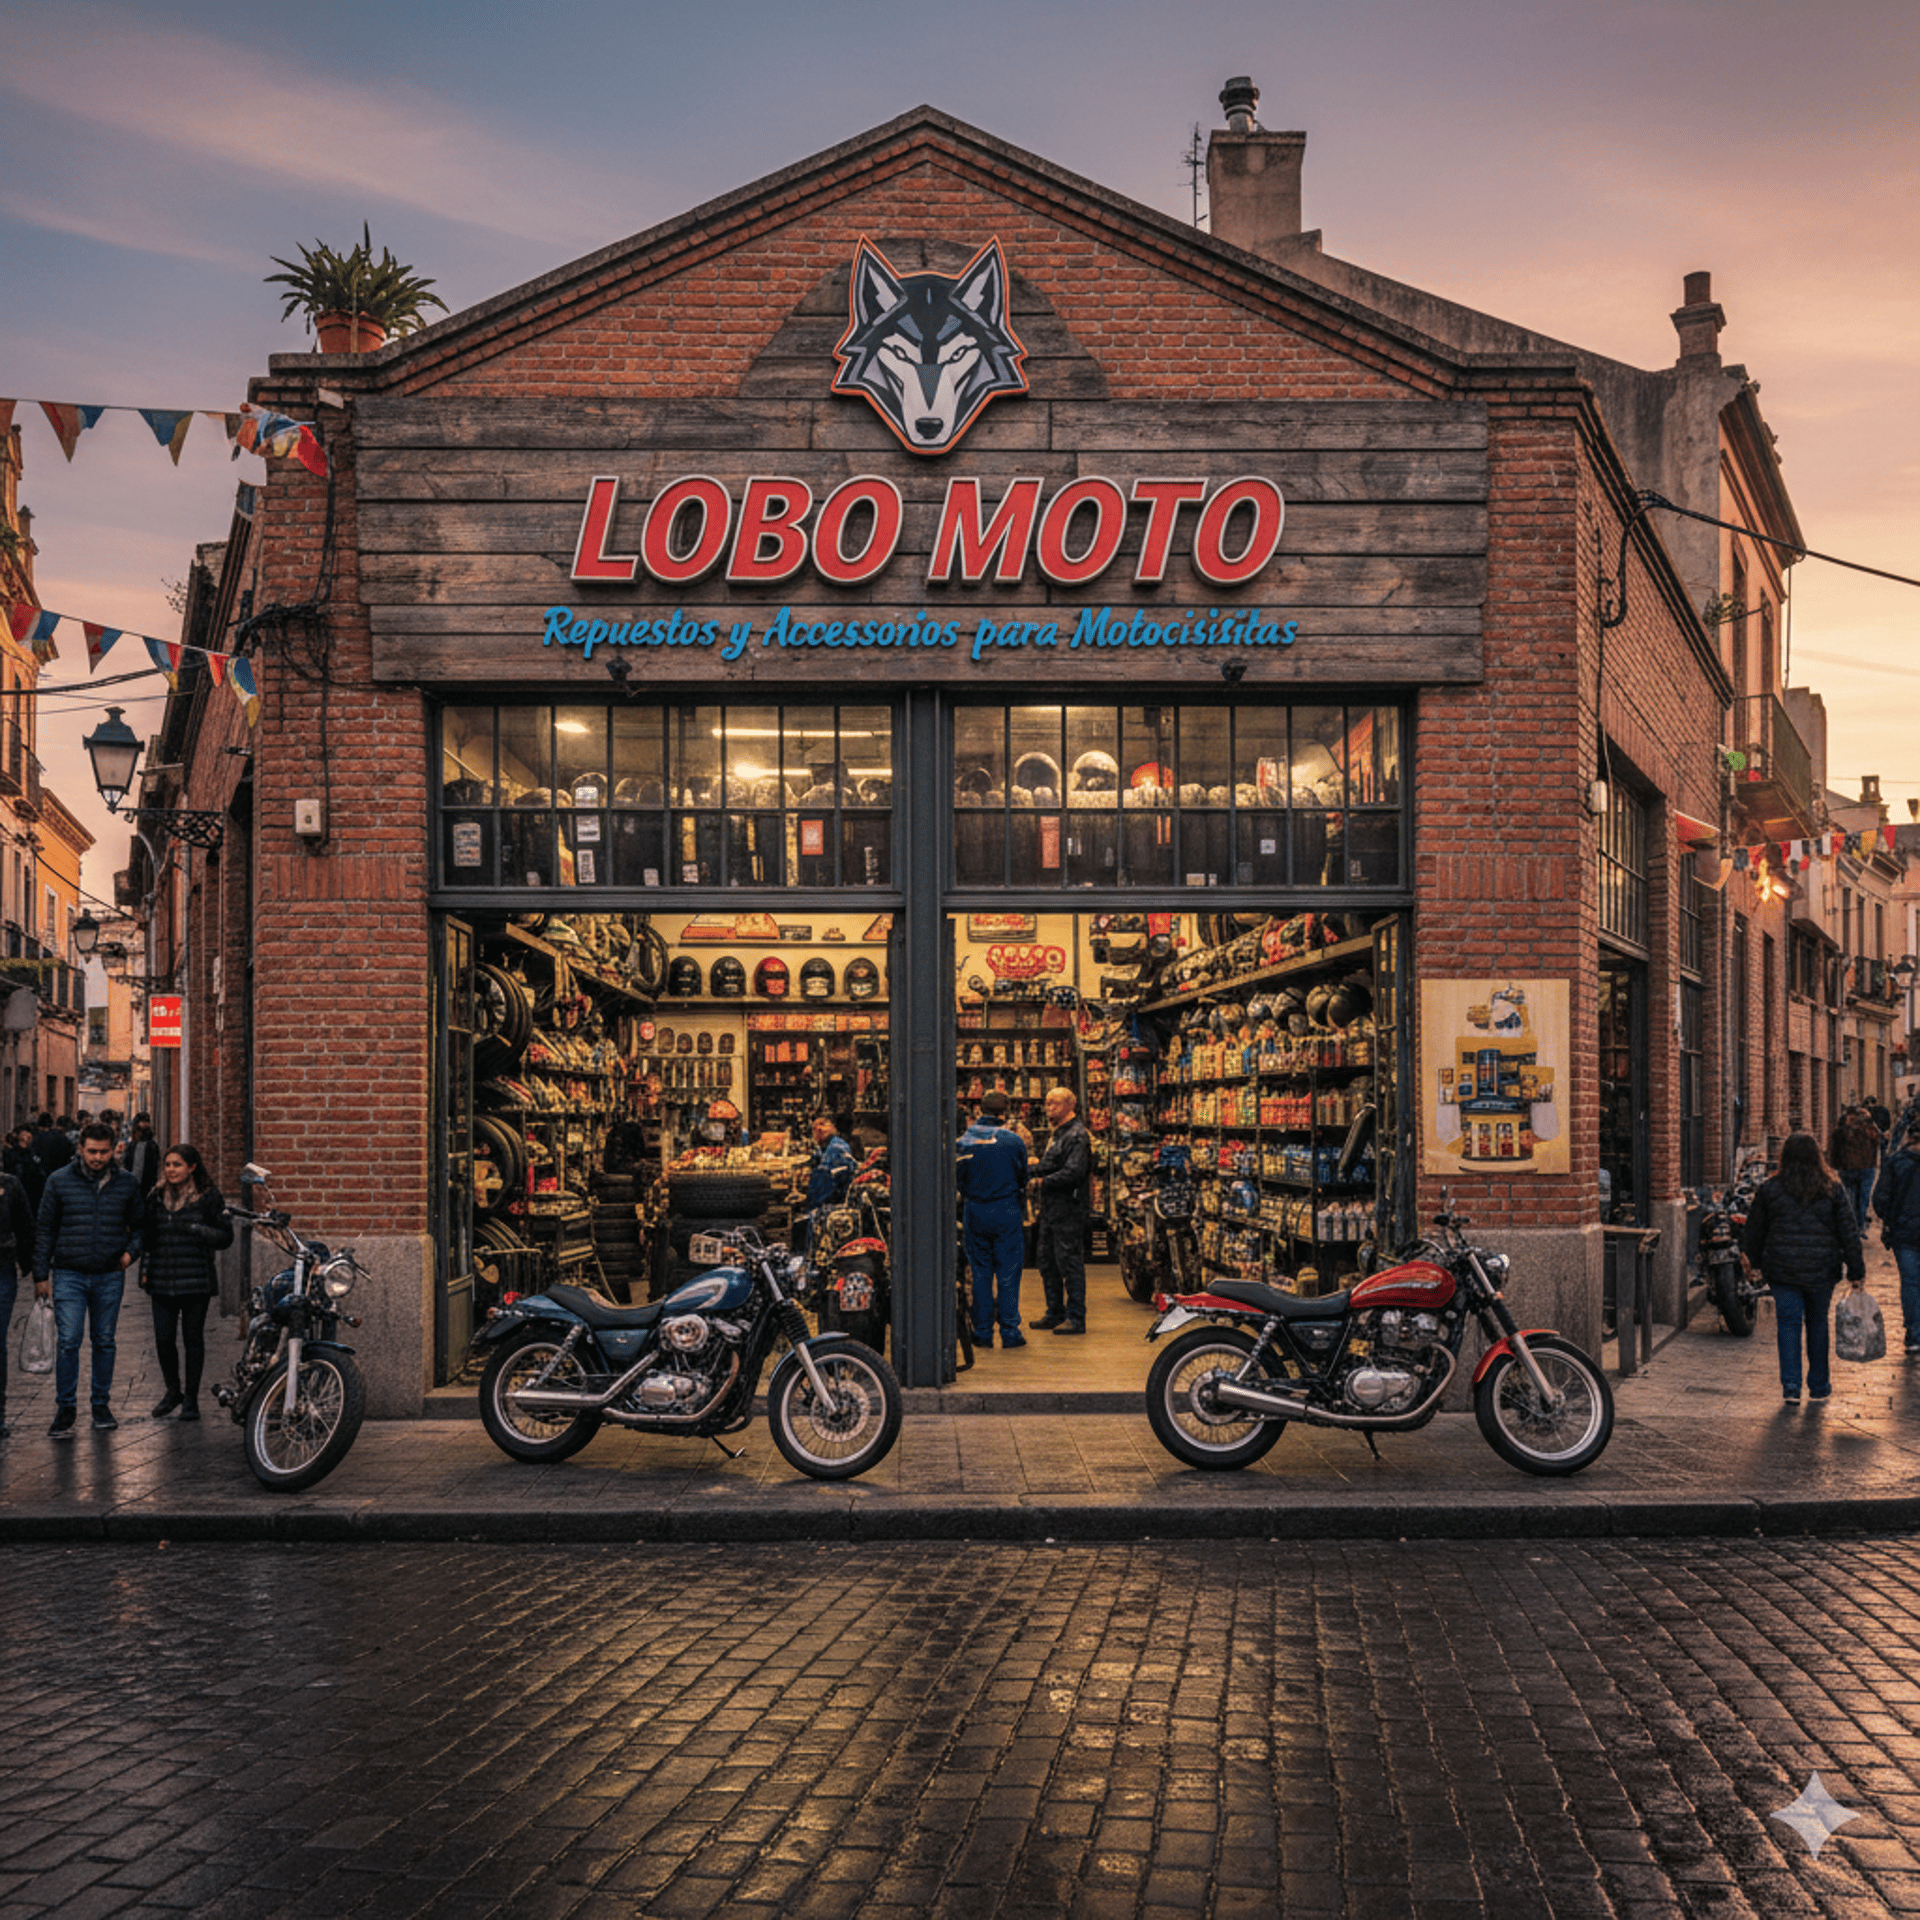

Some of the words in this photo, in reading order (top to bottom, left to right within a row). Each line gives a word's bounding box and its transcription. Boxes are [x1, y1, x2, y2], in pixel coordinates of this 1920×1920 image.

[570, 475, 903, 585] LOBO
[927, 475, 1286, 585] MOTO
[543, 606, 720, 659] Repuestos
[721, 621, 753, 660] y
[763, 606, 960, 647] Accessorios
[971, 618, 1058, 660] para
